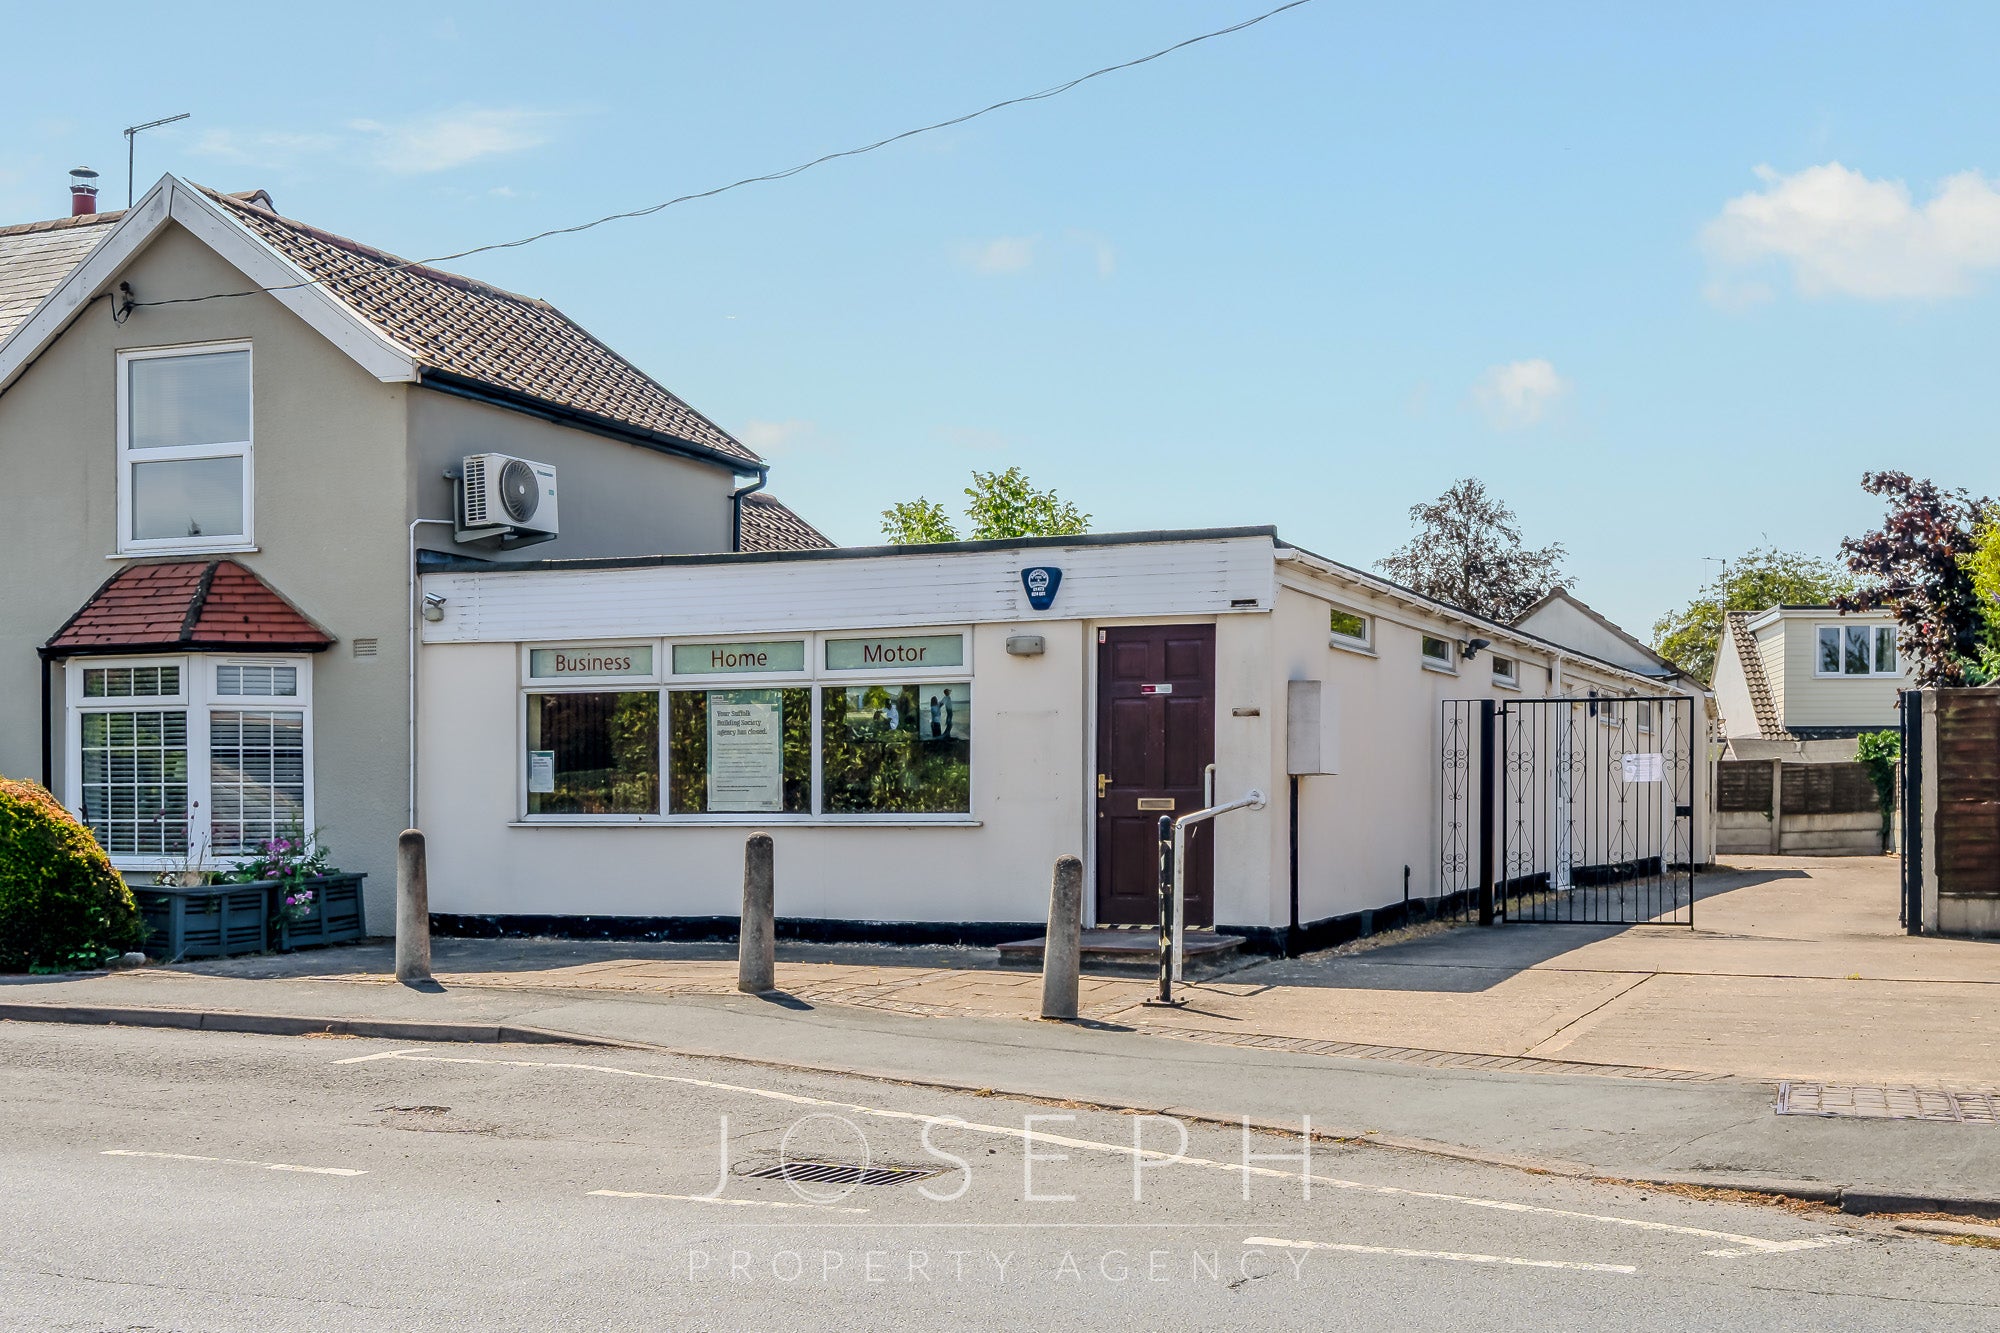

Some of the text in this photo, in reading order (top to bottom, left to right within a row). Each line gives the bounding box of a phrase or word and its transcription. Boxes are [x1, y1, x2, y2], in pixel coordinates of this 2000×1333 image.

[711, 649, 768, 668] Home
[864, 644, 927, 663] Motor
[555, 654, 631, 672] Business
[716, 719, 762, 727] Building Society
[716, 729, 736, 737] agency
